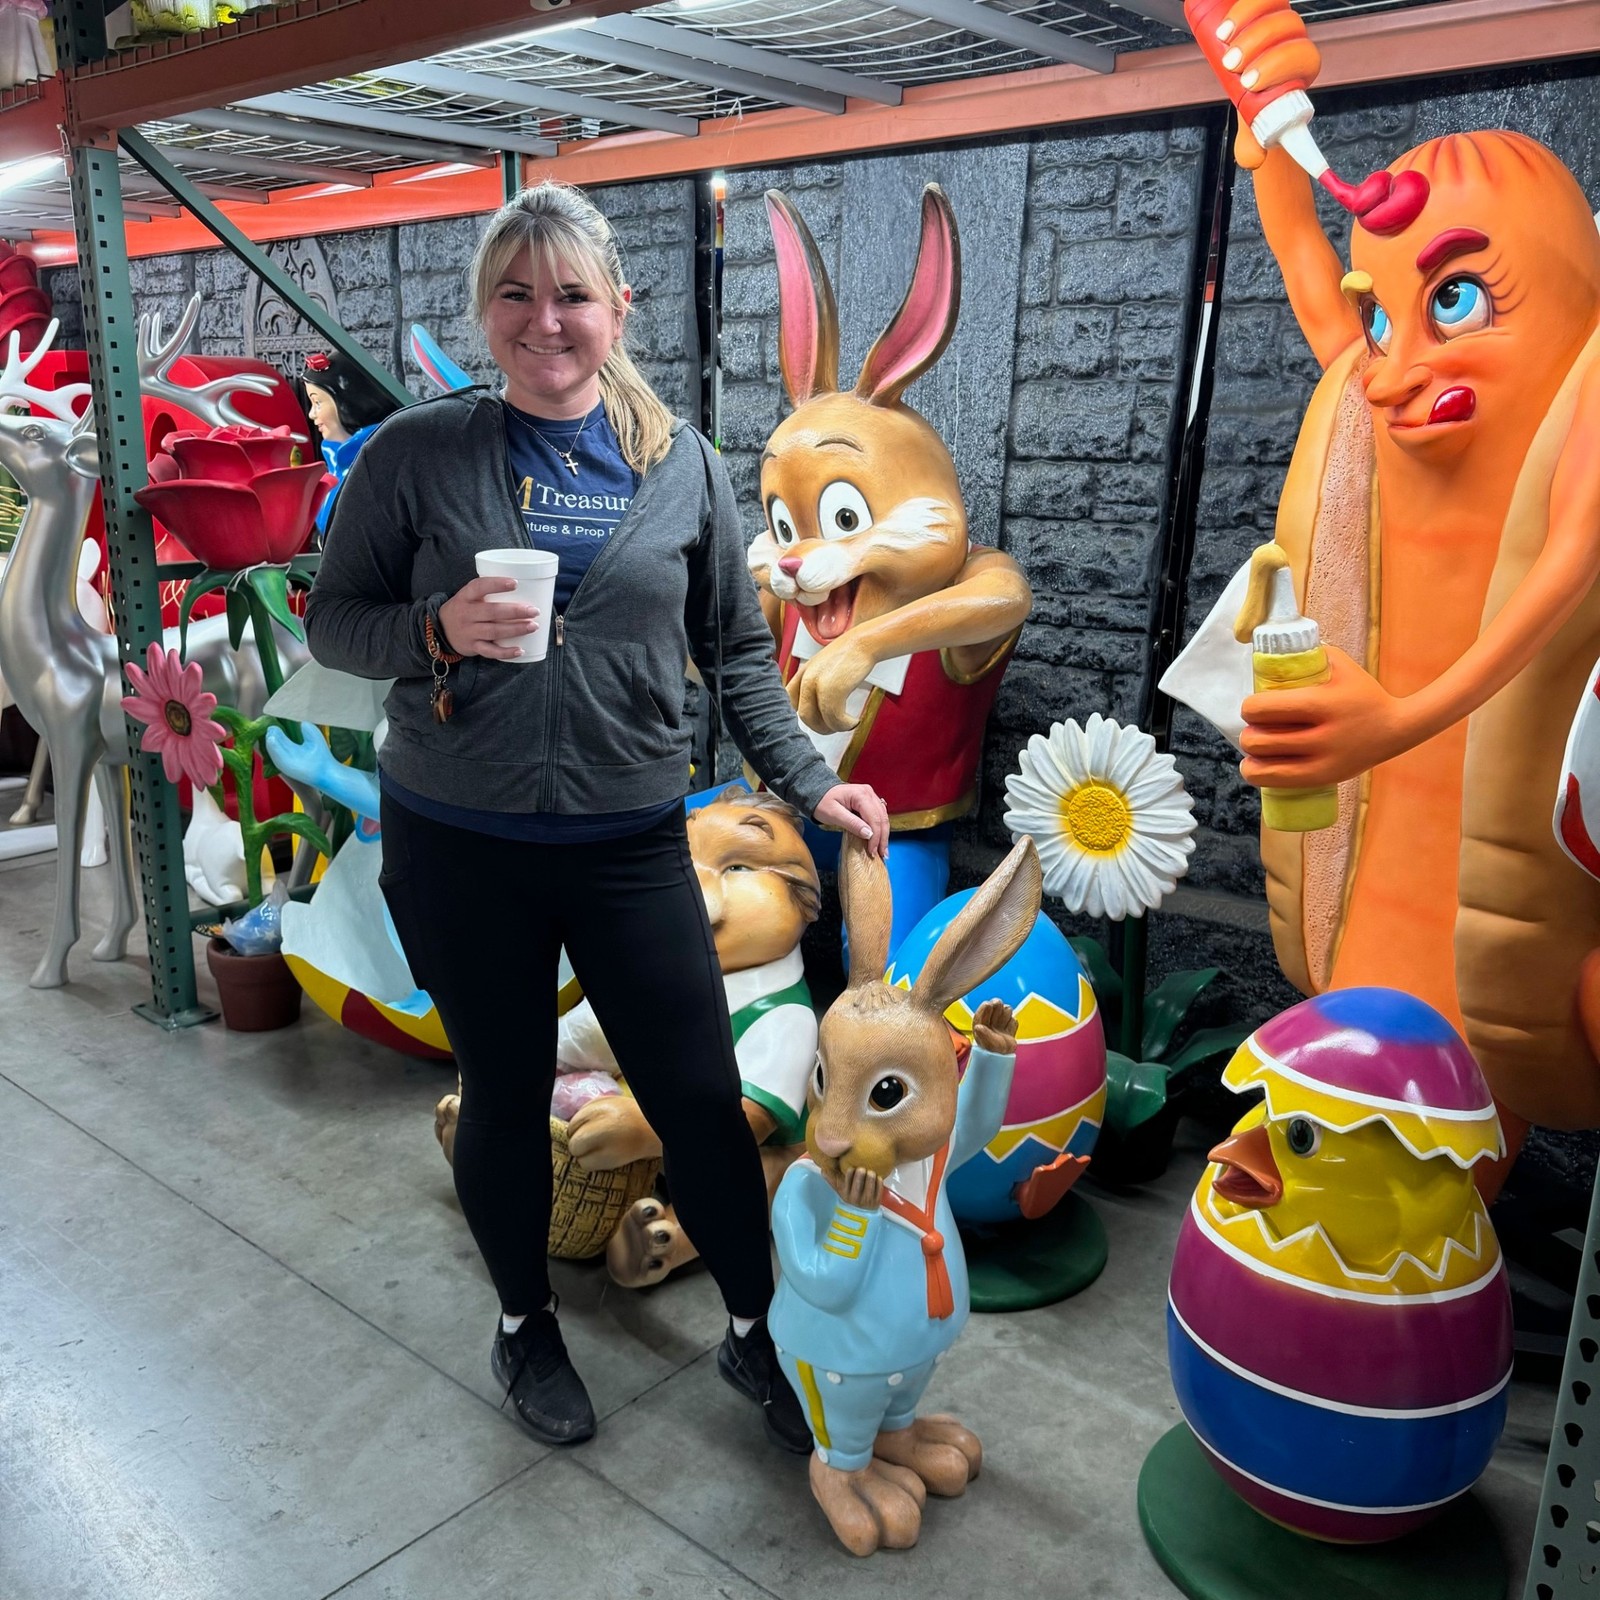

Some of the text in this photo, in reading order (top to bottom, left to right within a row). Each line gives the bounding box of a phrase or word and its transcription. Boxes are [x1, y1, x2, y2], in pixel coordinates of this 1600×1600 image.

[536, 483, 633, 511] Treasur
[561, 524, 571, 535] &
[575, 525, 605, 538] Prop
